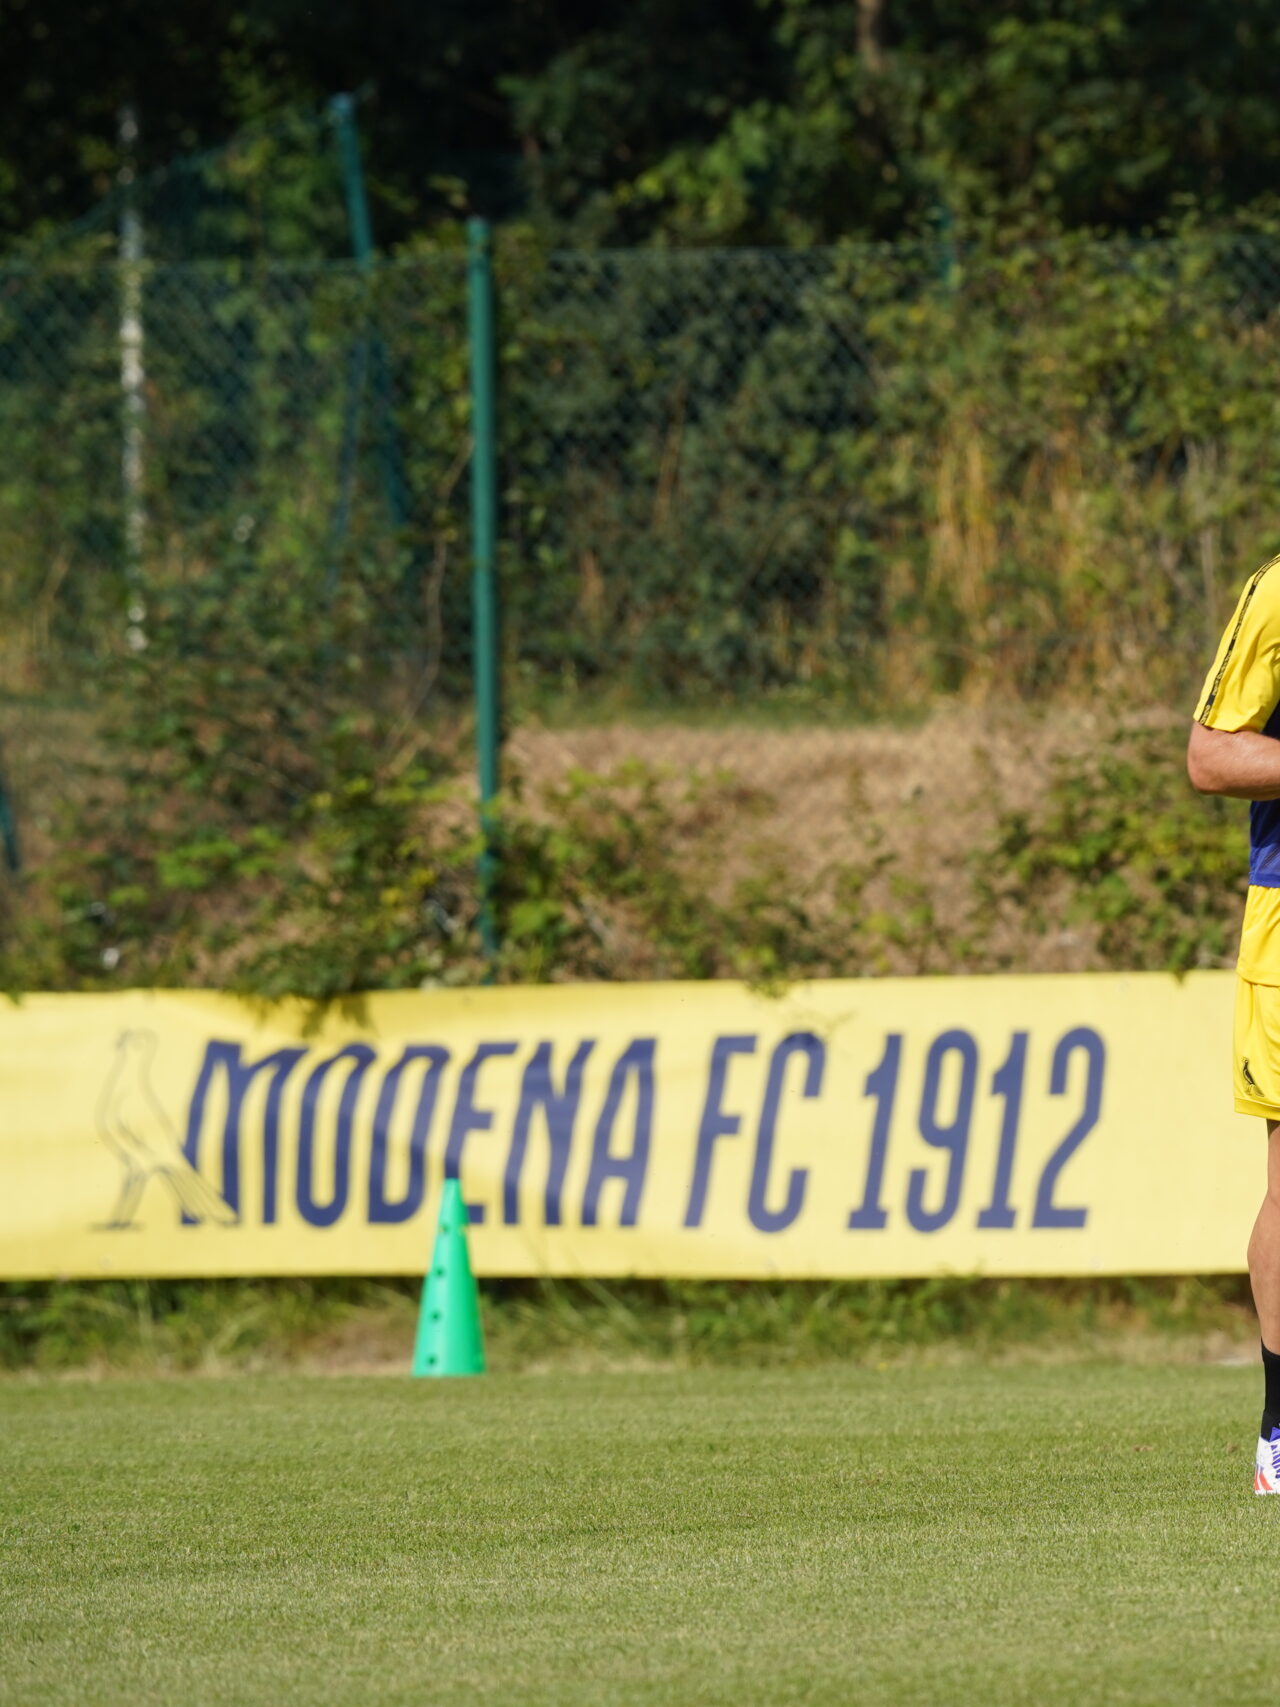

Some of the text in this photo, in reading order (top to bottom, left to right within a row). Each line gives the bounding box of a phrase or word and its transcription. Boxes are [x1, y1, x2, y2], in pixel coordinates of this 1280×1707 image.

[180, 1026, 1107, 1234] MODENA FC 1912
